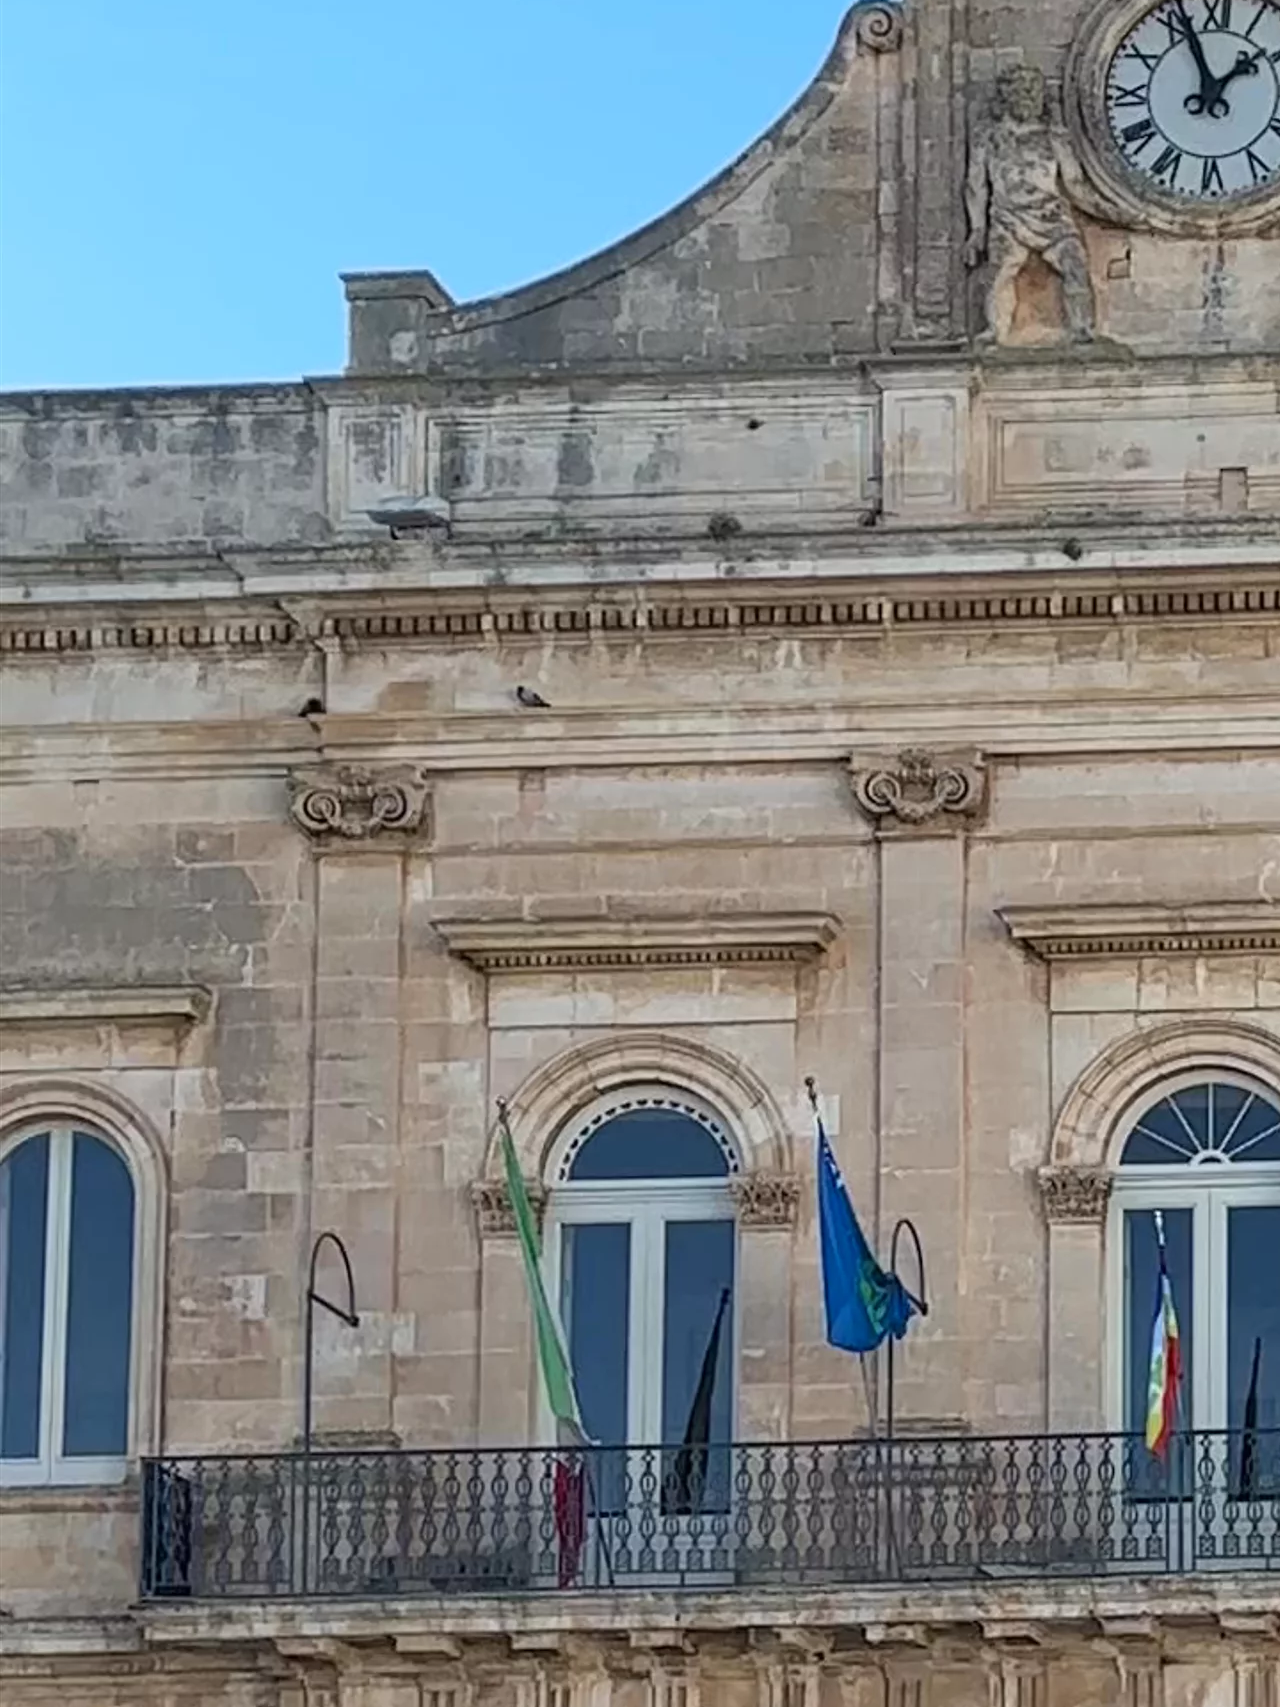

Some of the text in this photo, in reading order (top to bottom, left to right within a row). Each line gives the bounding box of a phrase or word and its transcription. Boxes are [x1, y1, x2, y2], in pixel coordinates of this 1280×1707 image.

[1203, 0, 1232, 29] XII
[1123, 43, 1160, 71] X
[1113, 84, 1148, 106] IX
[1202, 158, 1223, 192] VI
[1246, 148, 1270, 184] V
